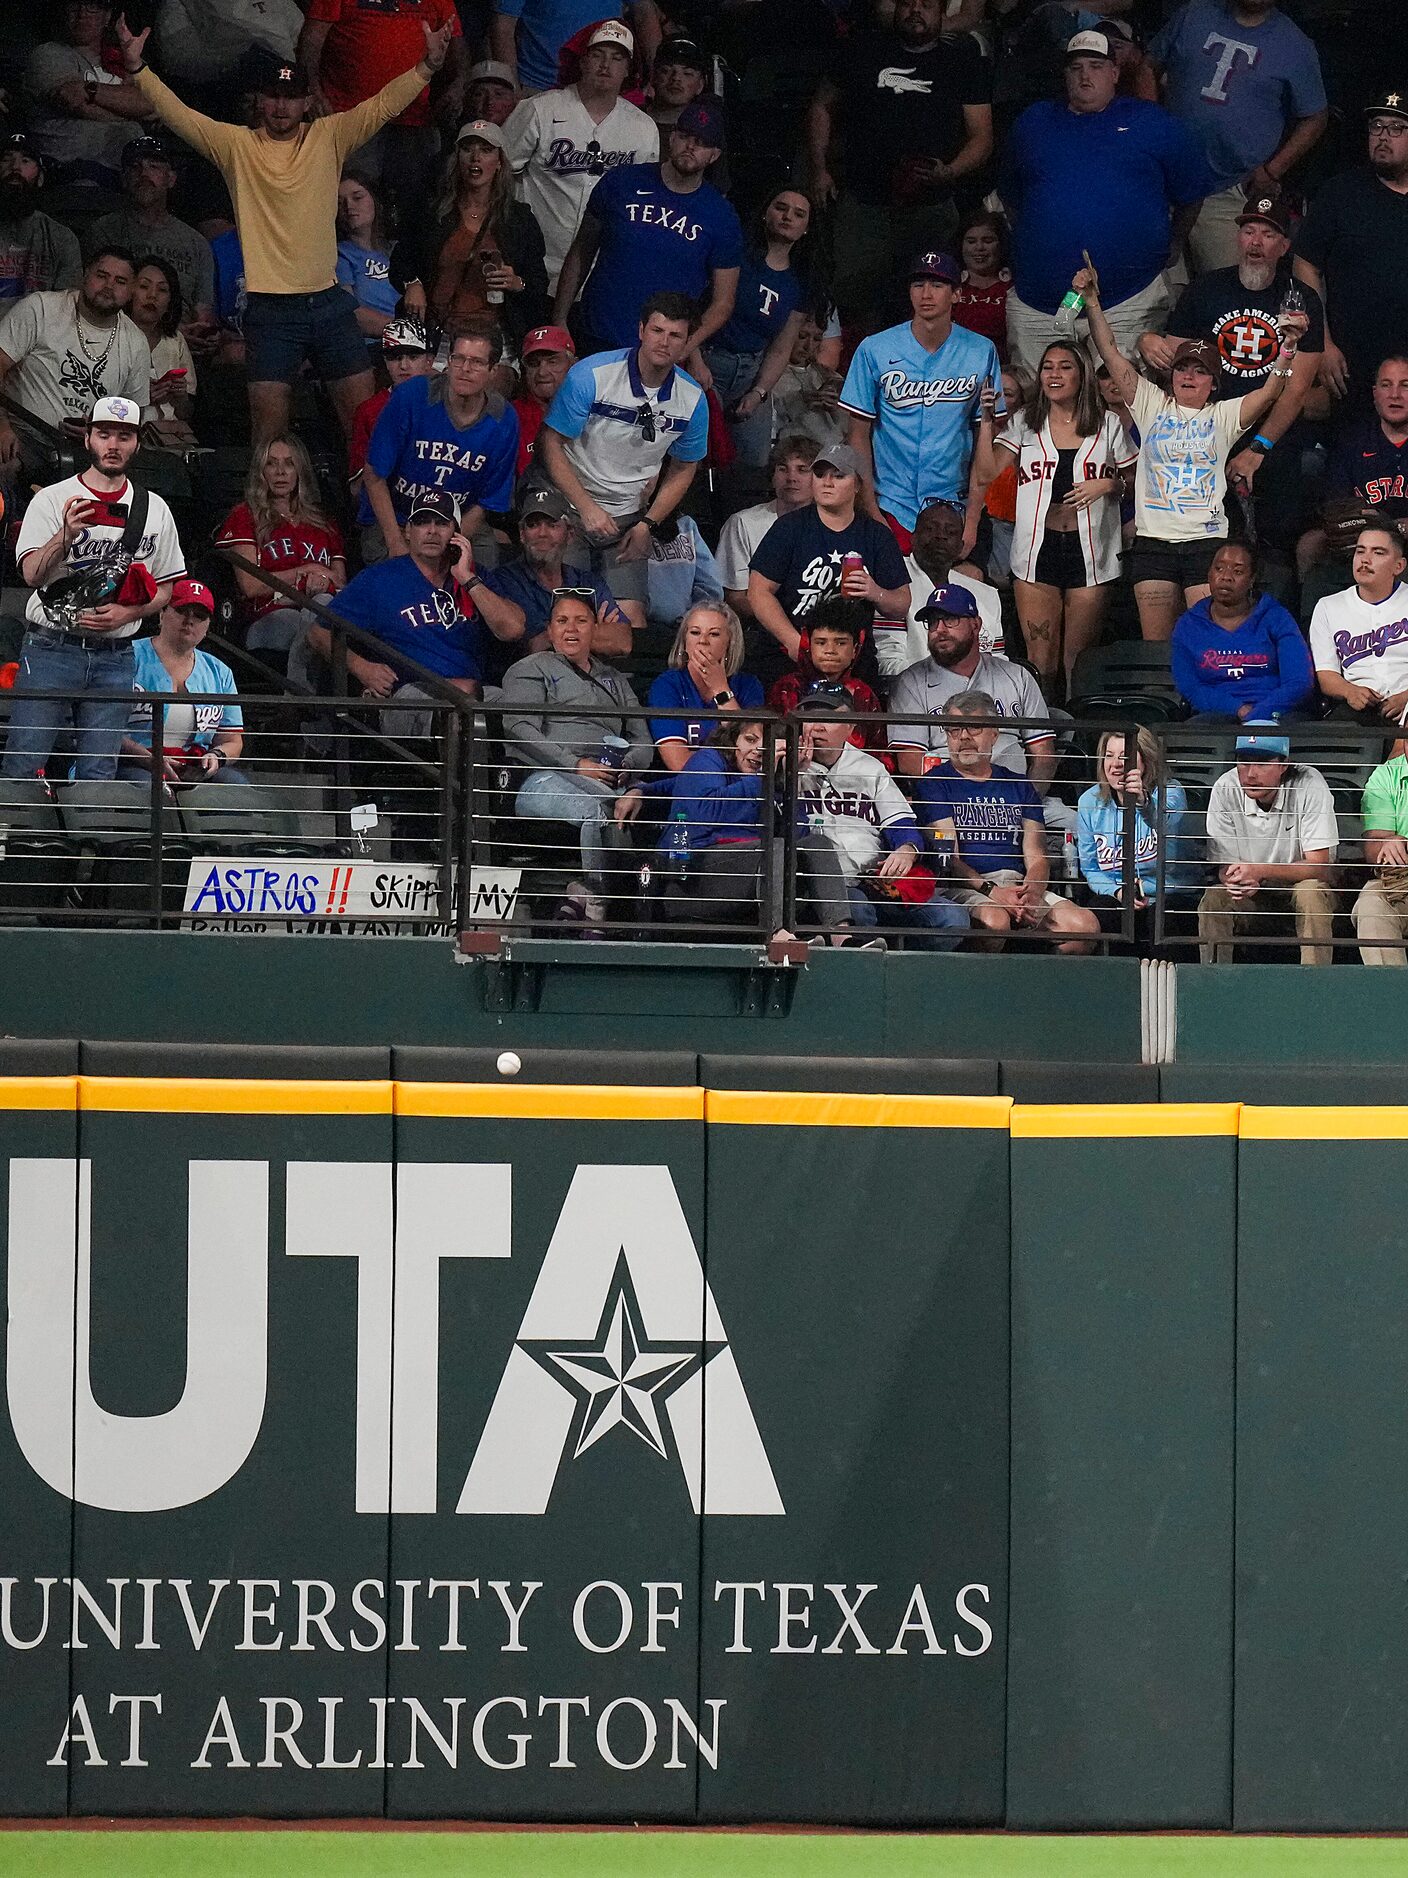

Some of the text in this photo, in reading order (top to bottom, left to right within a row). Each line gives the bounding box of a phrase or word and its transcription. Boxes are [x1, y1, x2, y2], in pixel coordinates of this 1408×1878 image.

[278, 66, 293, 81] H
[1202, 31, 1260, 102] T
[625, 202, 704, 242] TEXAS
[758, 284, 779, 316] T
[535, 329, 548, 341] T
[1211, 308, 1241, 336] MAKE
[1230, 325, 1265, 361] H
[880, 369, 978, 406] Rangers
[415, 440, 487, 472] TEXAS
[433, 465, 453, 487] T
[535, 491, 548, 503] T
[801, 556, 834, 590] GO
[189, 582, 204, 595] T
[933, 589, 948, 602] T
[1200, 650, 1270, 669] Rangers
[967, 796, 1006, 804] TEXAS
[954, 803, 1022, 828] RANGERS
[8, 1157, 786, 1514] UTA
[0, 1577, 993, 1657] UNIVERSITY OF TEXAS
[46, 1692, 728, 1770] AT ARLINGTON
